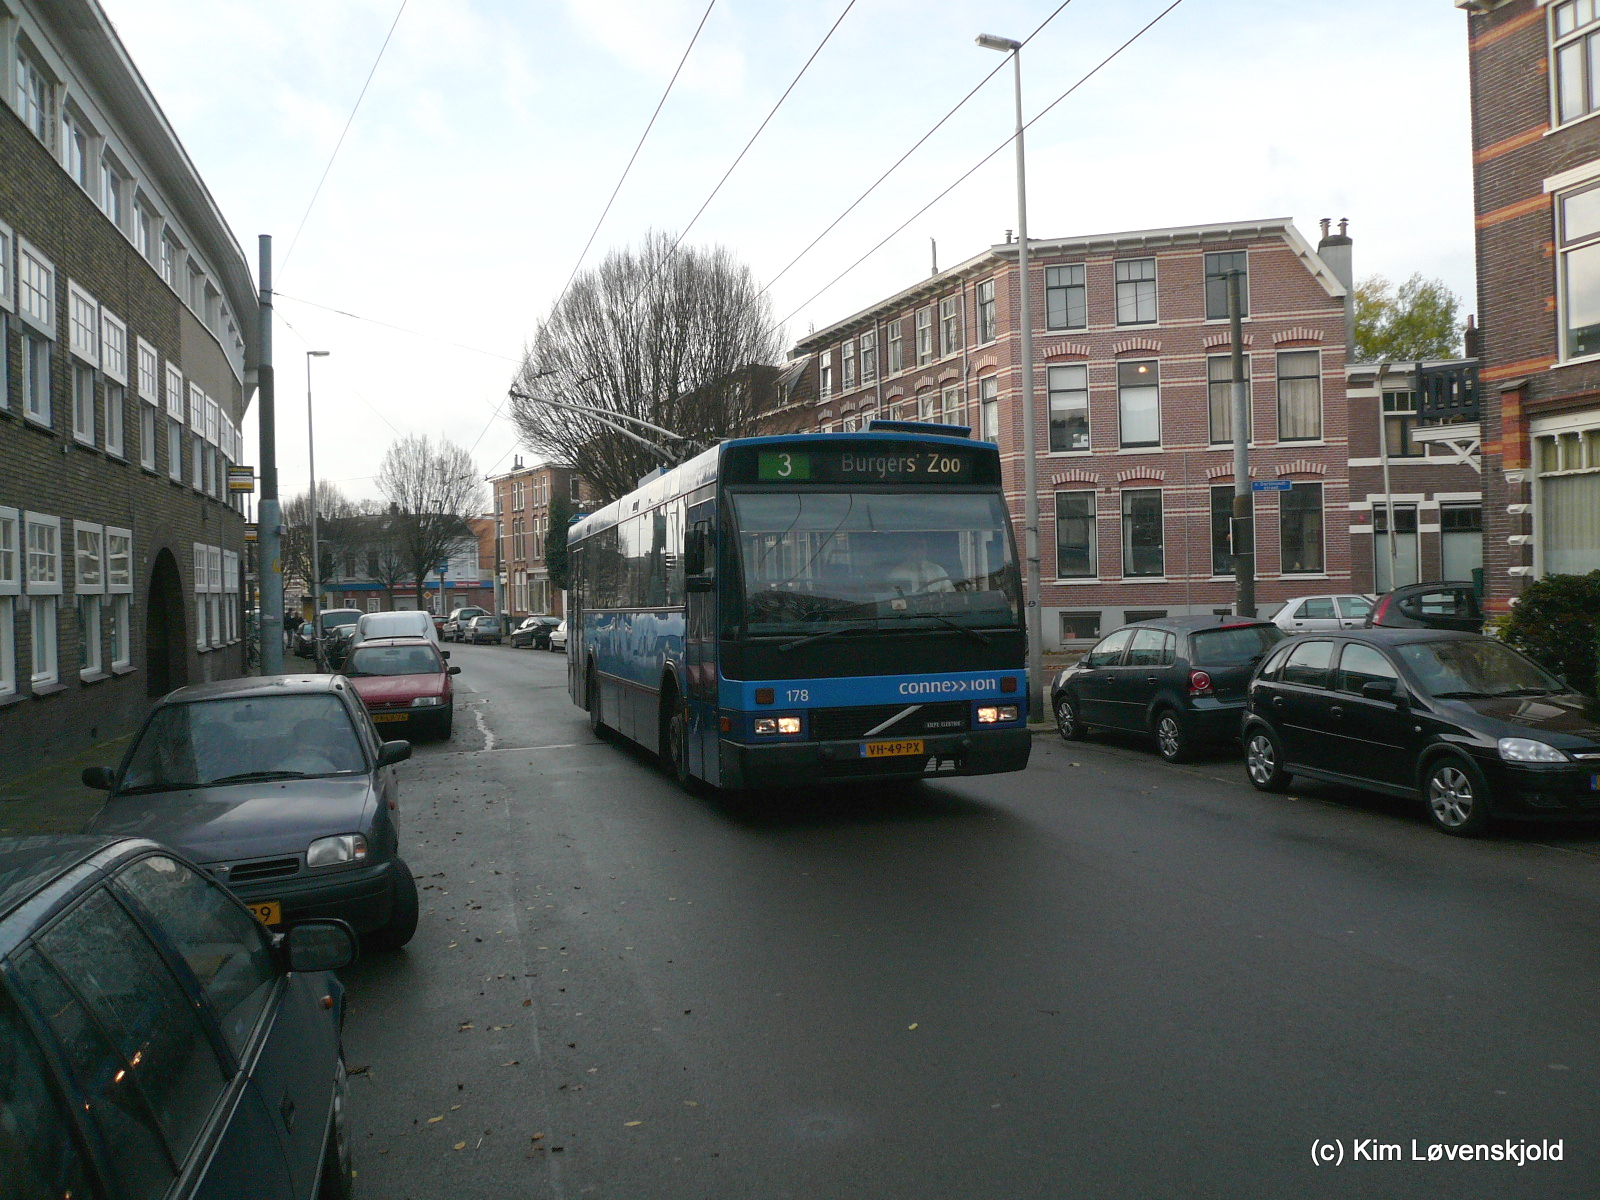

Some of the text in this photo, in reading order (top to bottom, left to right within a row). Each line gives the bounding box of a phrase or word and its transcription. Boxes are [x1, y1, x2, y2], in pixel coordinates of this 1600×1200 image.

[776, 453, 793, 477] 3
[927, 453, 961, 473] Zoo
[786, 689, 809, 702] 178
[868, 742, 920, 756] VH-49-PX
